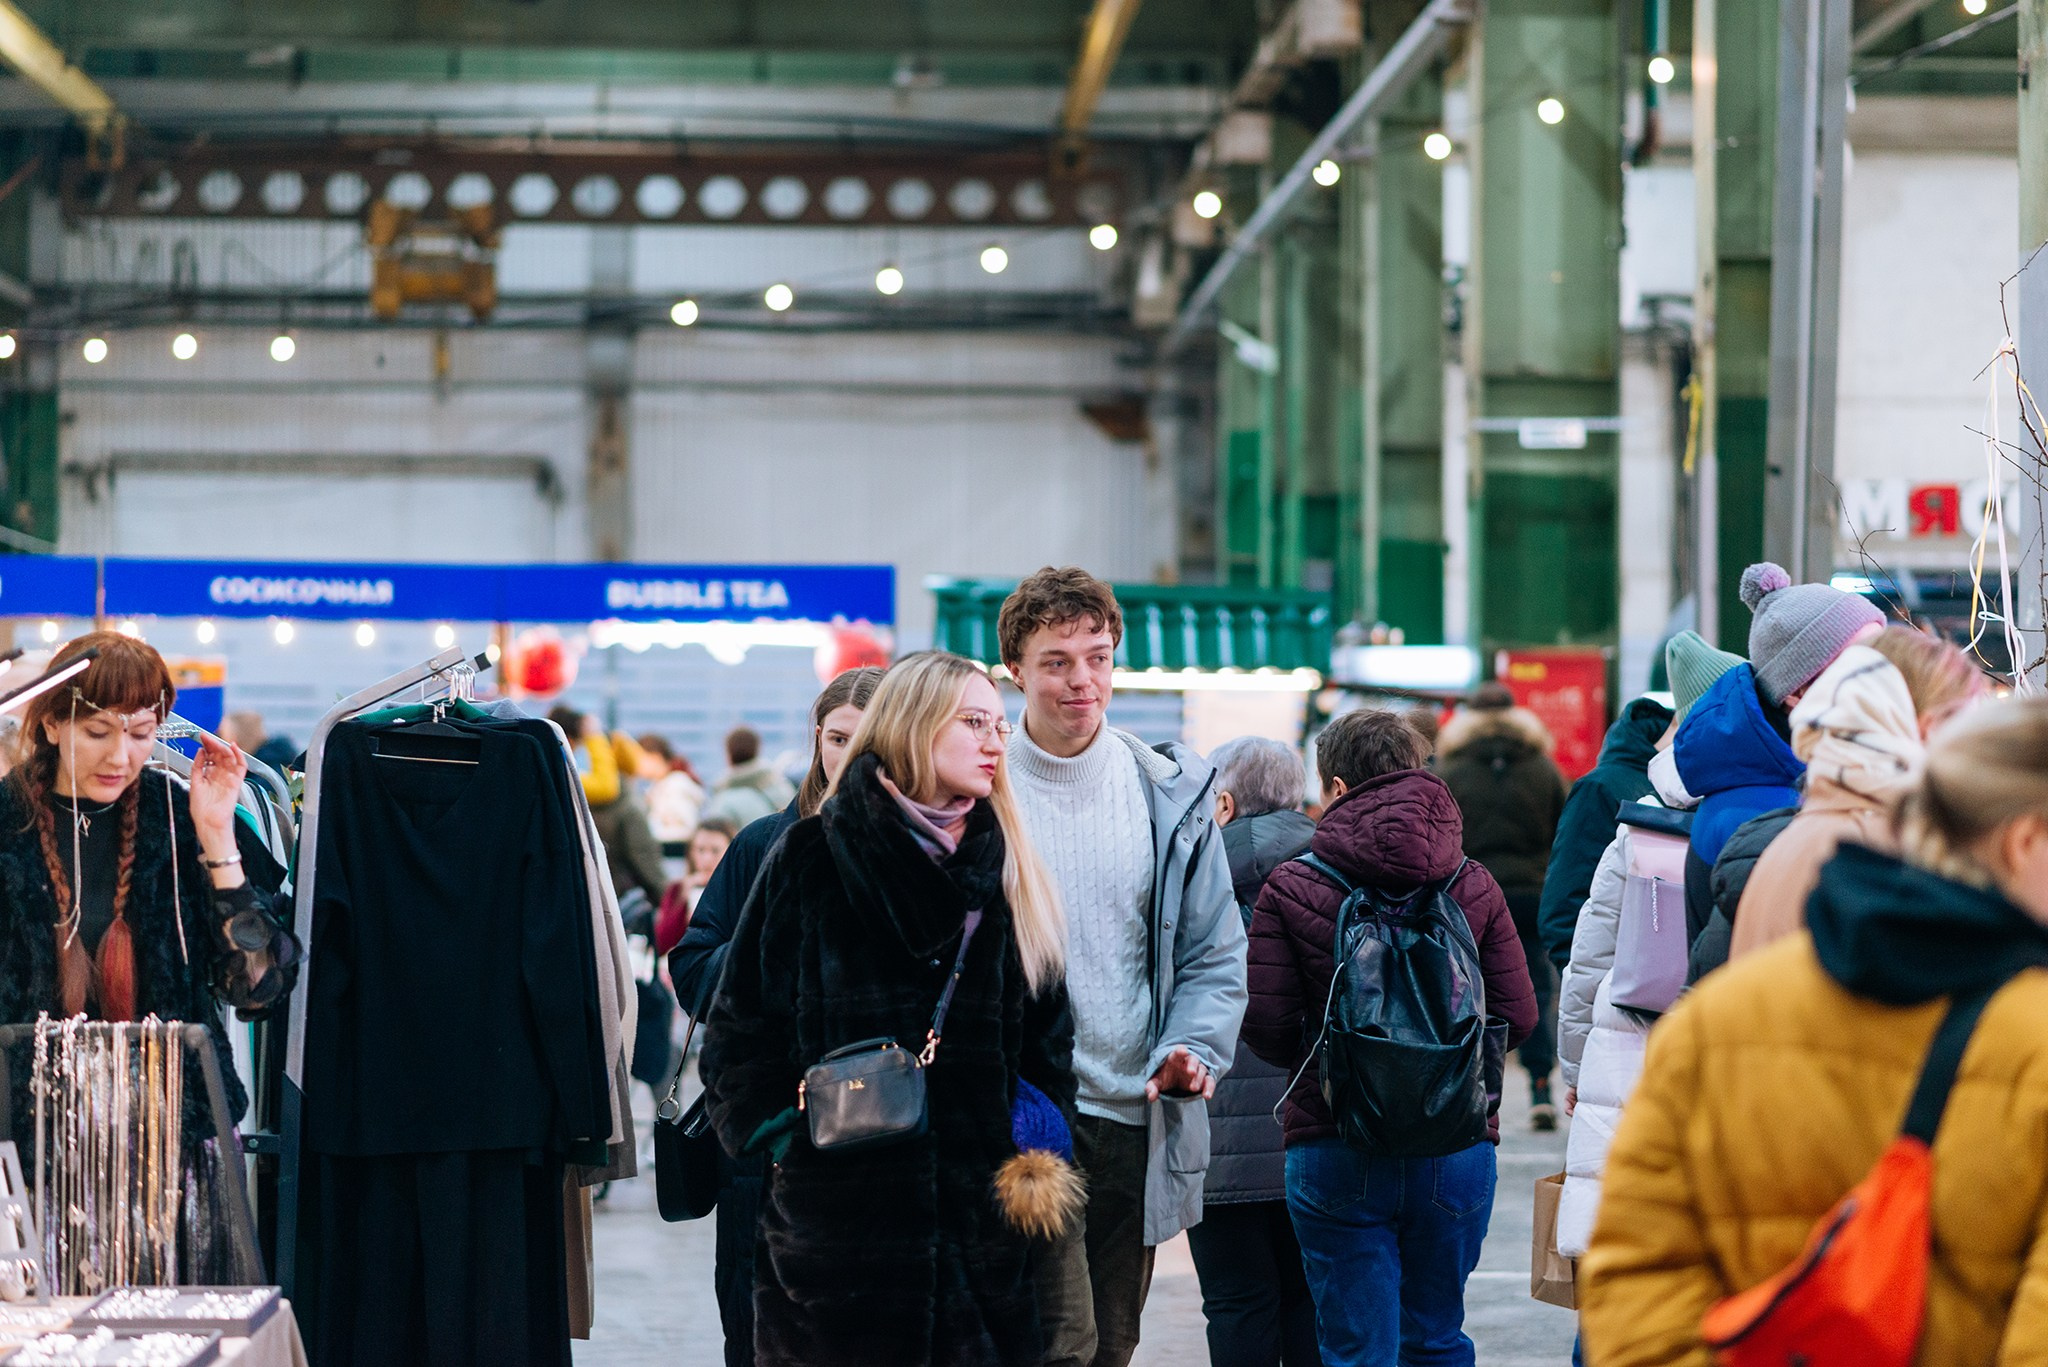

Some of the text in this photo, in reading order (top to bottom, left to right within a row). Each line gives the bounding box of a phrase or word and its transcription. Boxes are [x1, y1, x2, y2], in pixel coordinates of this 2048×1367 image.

[1838, 481, 2020, 541] МЯС
[210, 577, 394, 604] СОСИСОЧНАЯ
[607, 580, 789, 608] BUBBLE TEA
